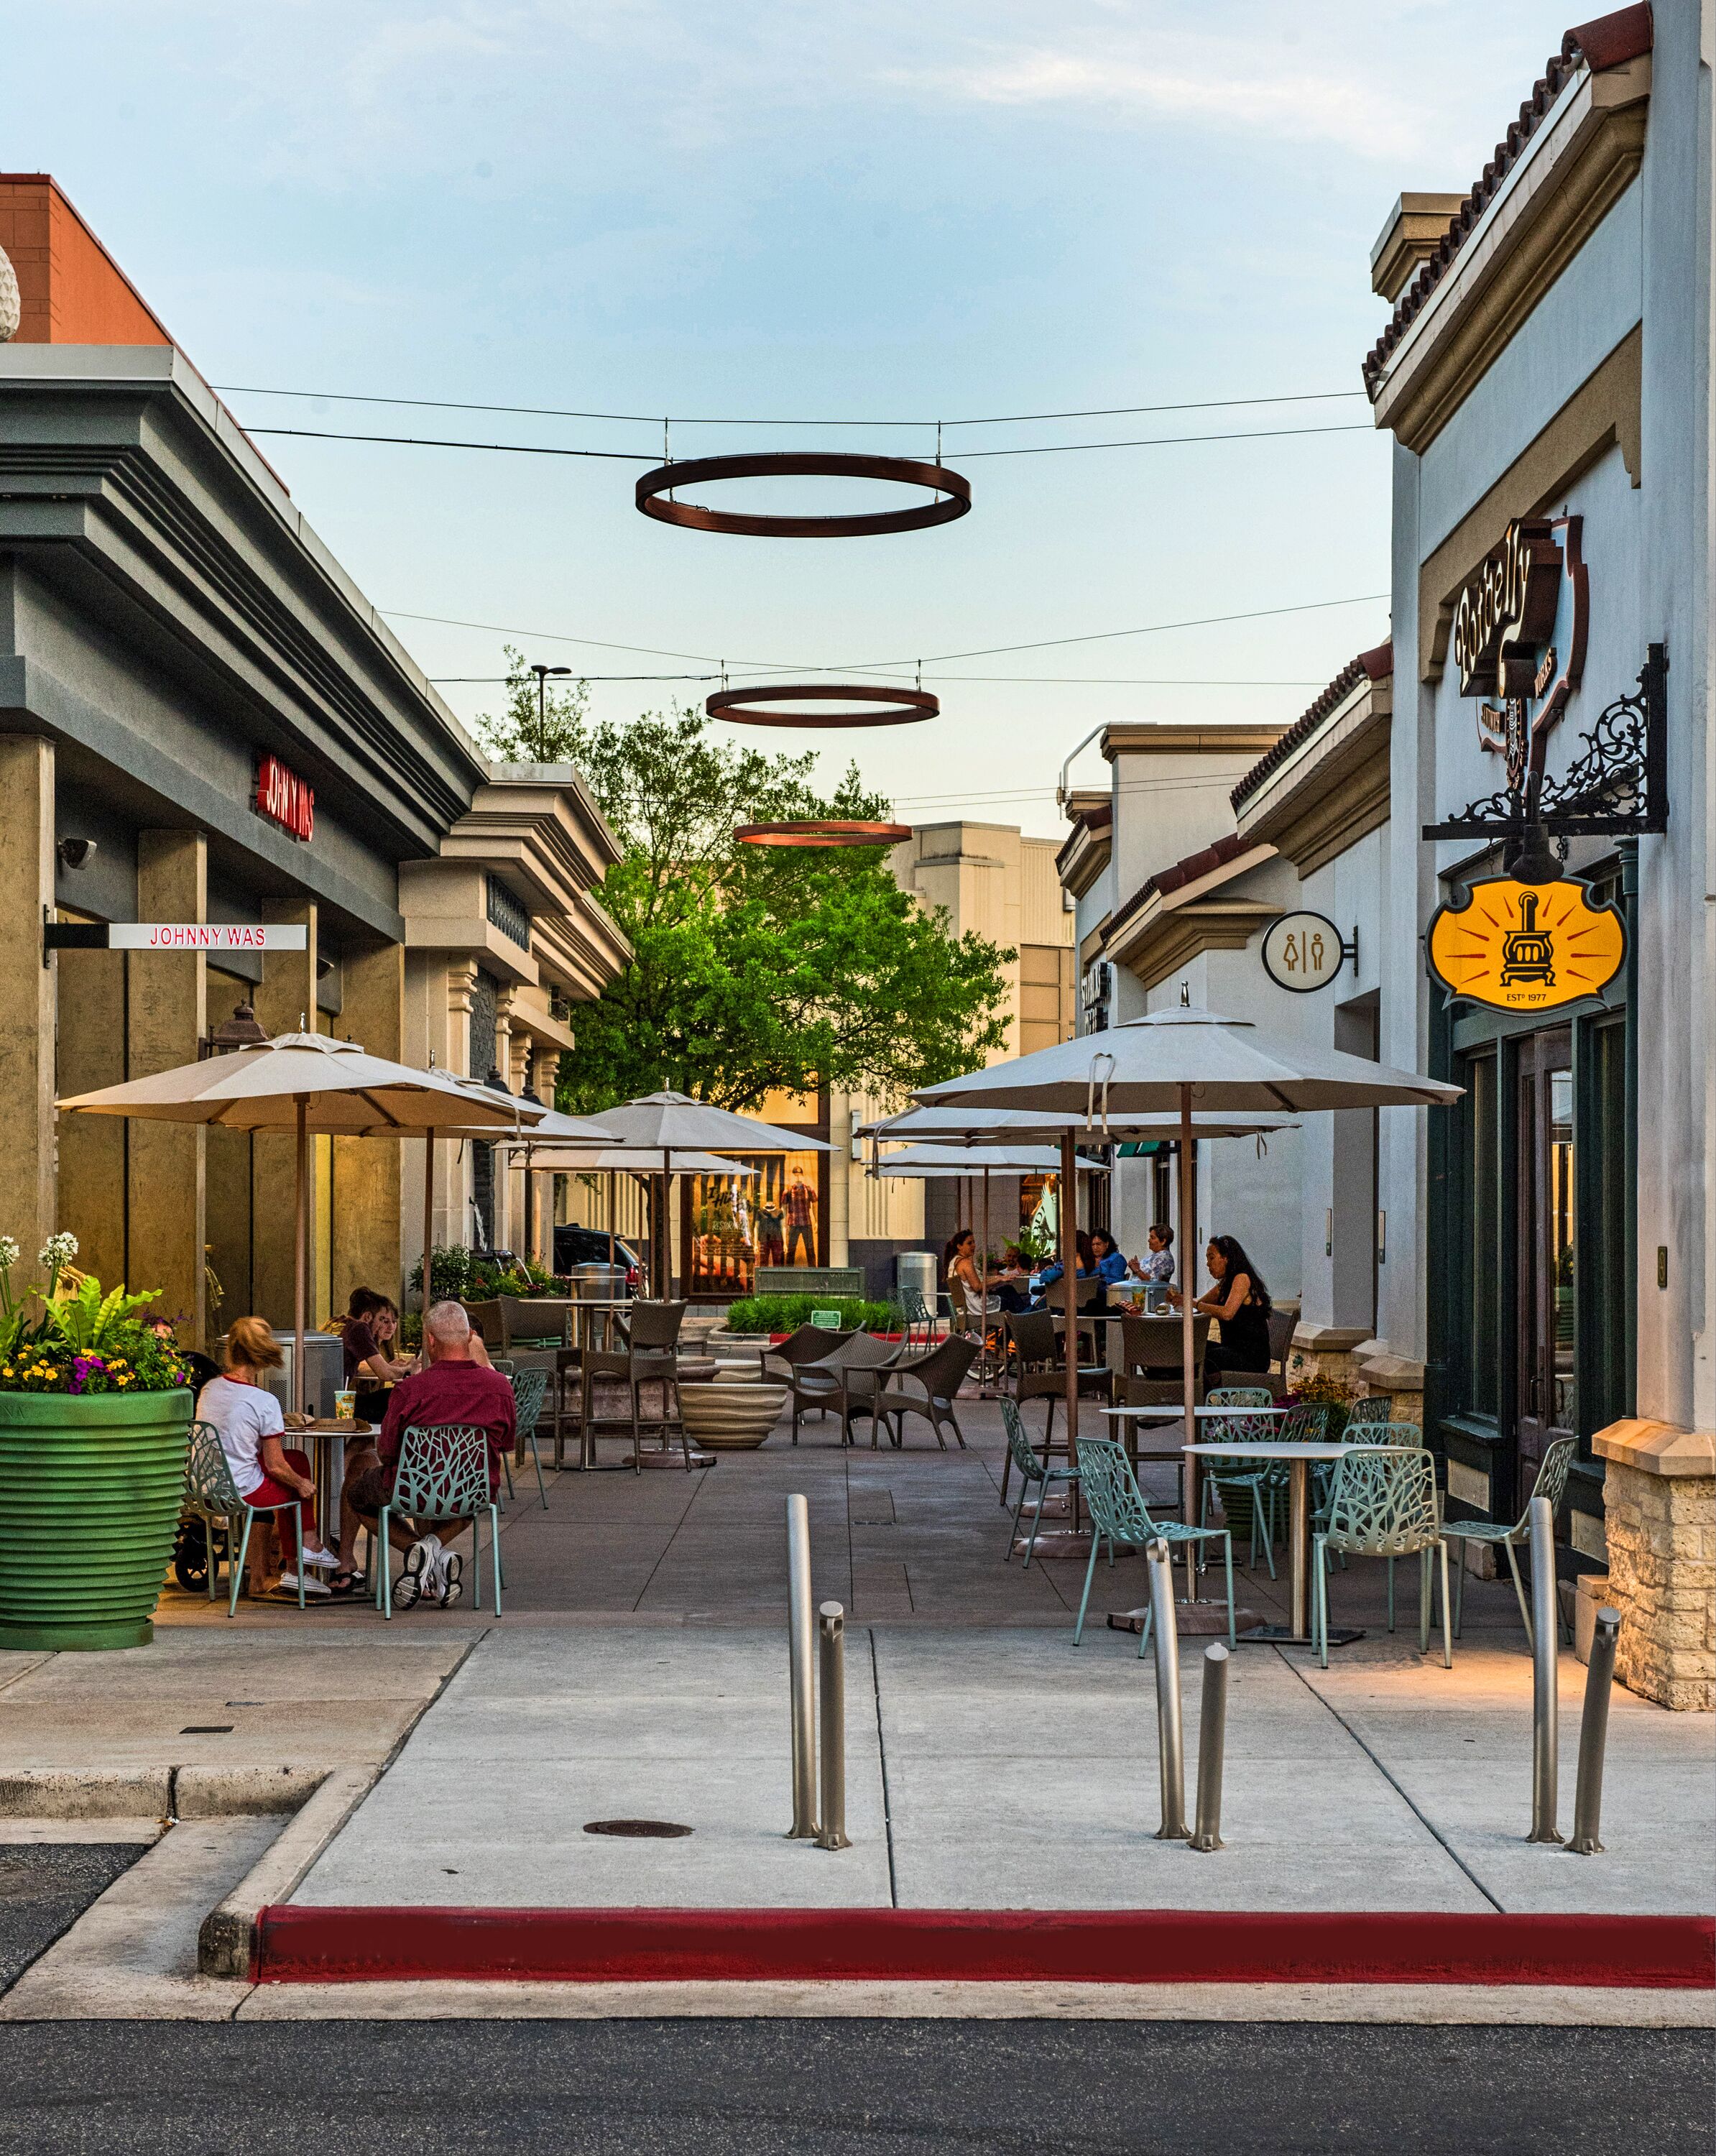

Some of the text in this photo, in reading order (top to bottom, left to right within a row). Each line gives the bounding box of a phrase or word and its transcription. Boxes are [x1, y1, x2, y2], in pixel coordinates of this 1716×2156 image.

[1455, 518, 1531, 699] Potbelly
[259, 752, 297, 829] JOHNY
[150, 927, 265, 946] JOHNNY WAS
